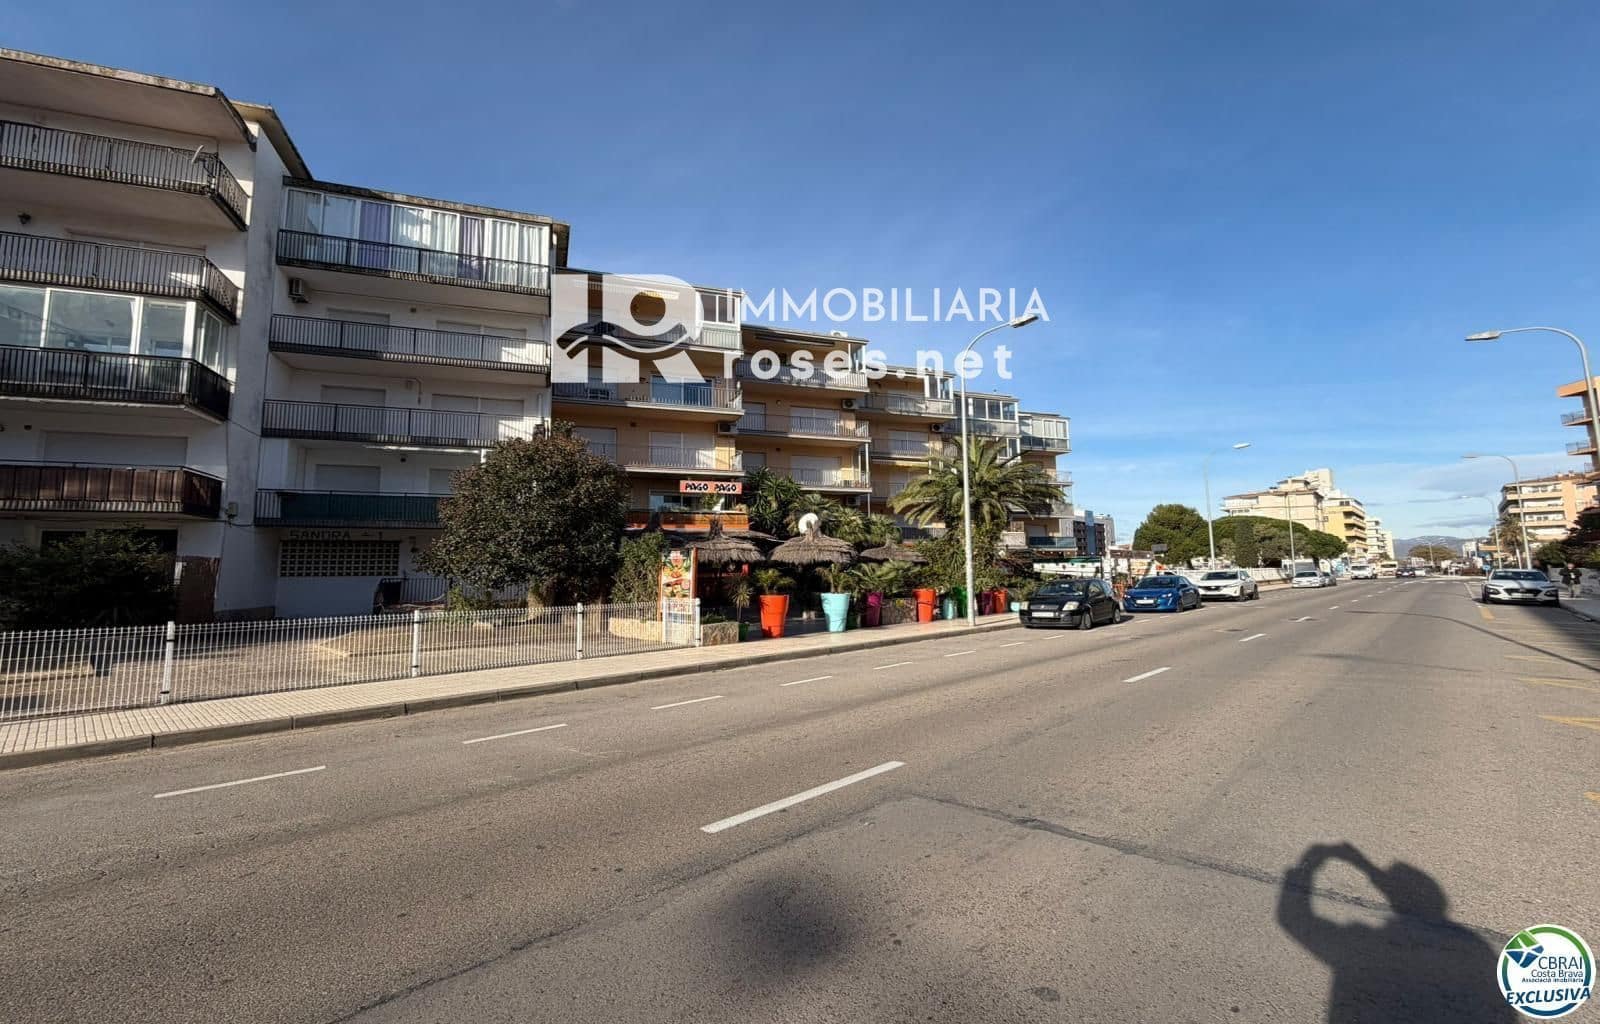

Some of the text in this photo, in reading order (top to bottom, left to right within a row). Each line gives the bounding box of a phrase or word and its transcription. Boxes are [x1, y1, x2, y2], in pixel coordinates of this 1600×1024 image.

[685, 483, 737, 492] PAGO PAGO
[289, 529, 351, 540] SANDRA
